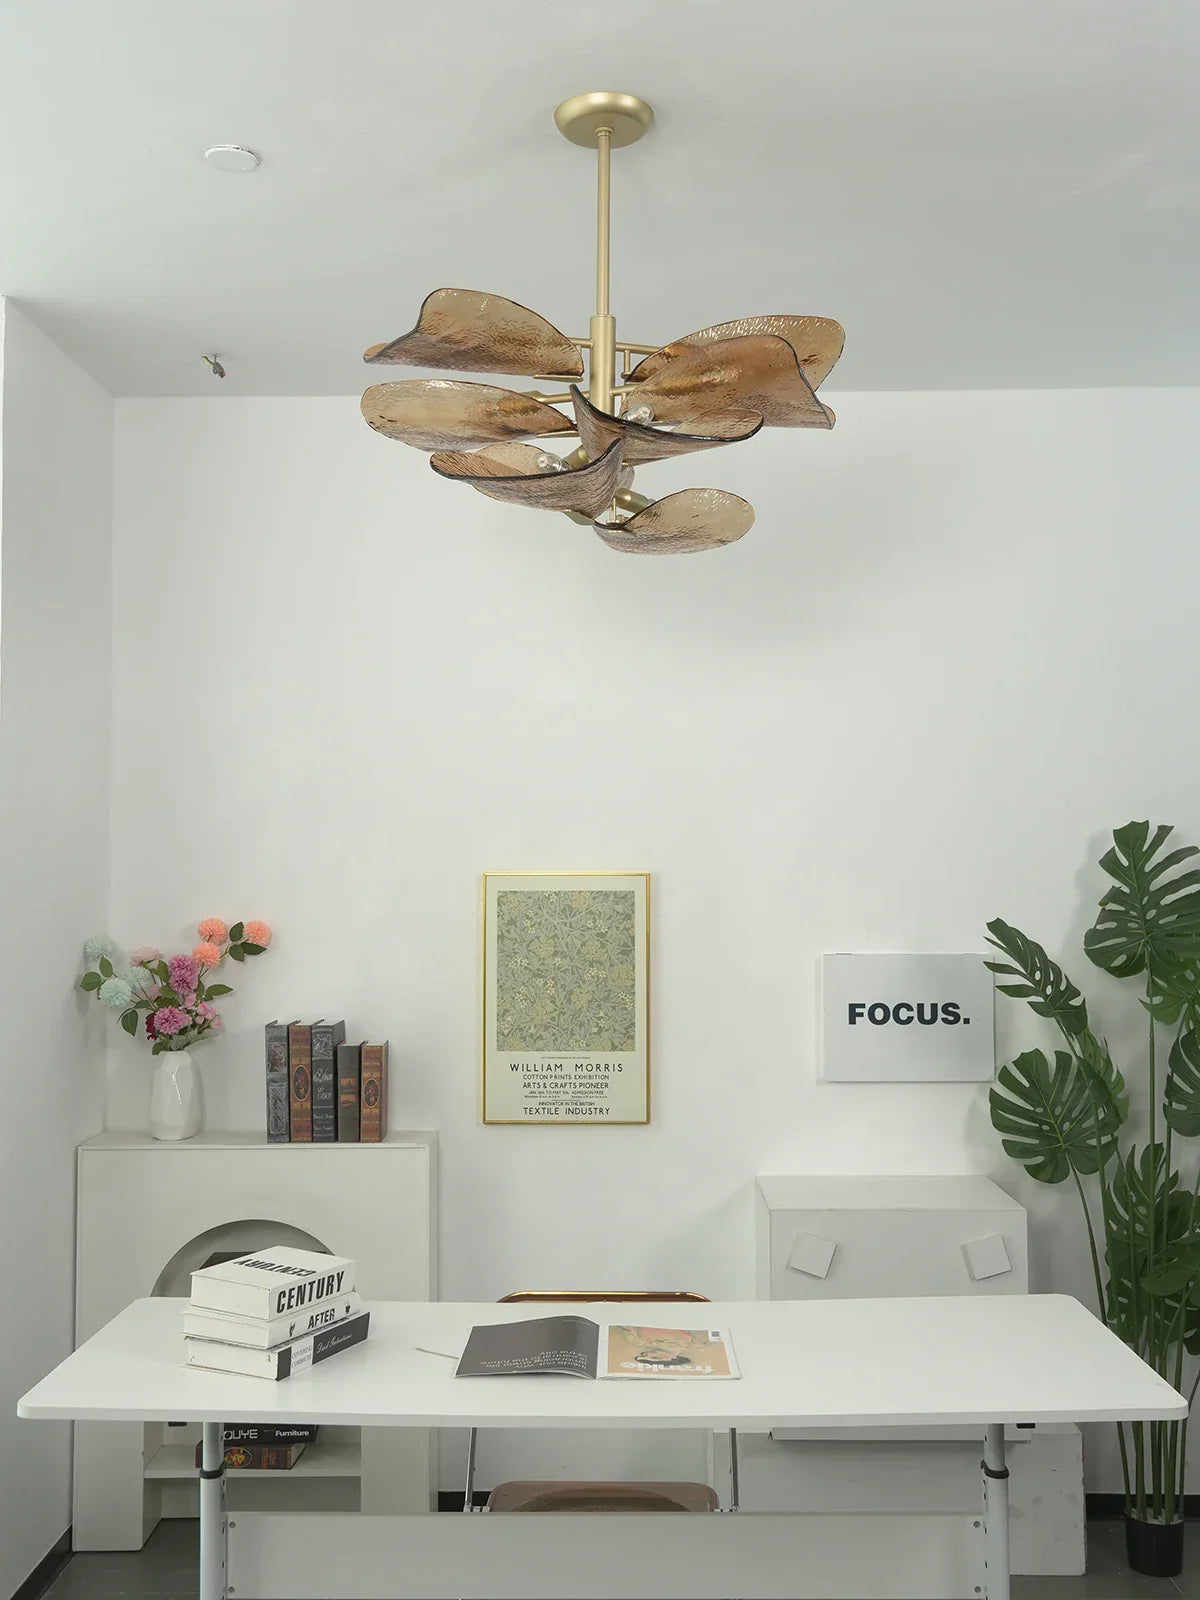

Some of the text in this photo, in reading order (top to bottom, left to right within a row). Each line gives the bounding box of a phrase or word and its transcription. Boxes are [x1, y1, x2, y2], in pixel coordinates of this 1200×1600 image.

[848, 1002, 971, 1026] FOCUS.
[509, 1063, 624, 1072] WILLIAM MORRIS
[523, 1107, 610, 1115] TEXTILE INDUSTRY
[232, 1259, 317, 1277] CENTURY
[276, 1270, 345, 1314] CENTURY
[307, 1308, 336, 1330] AFTER
[275, 1429, 310, 1437] Furniture
